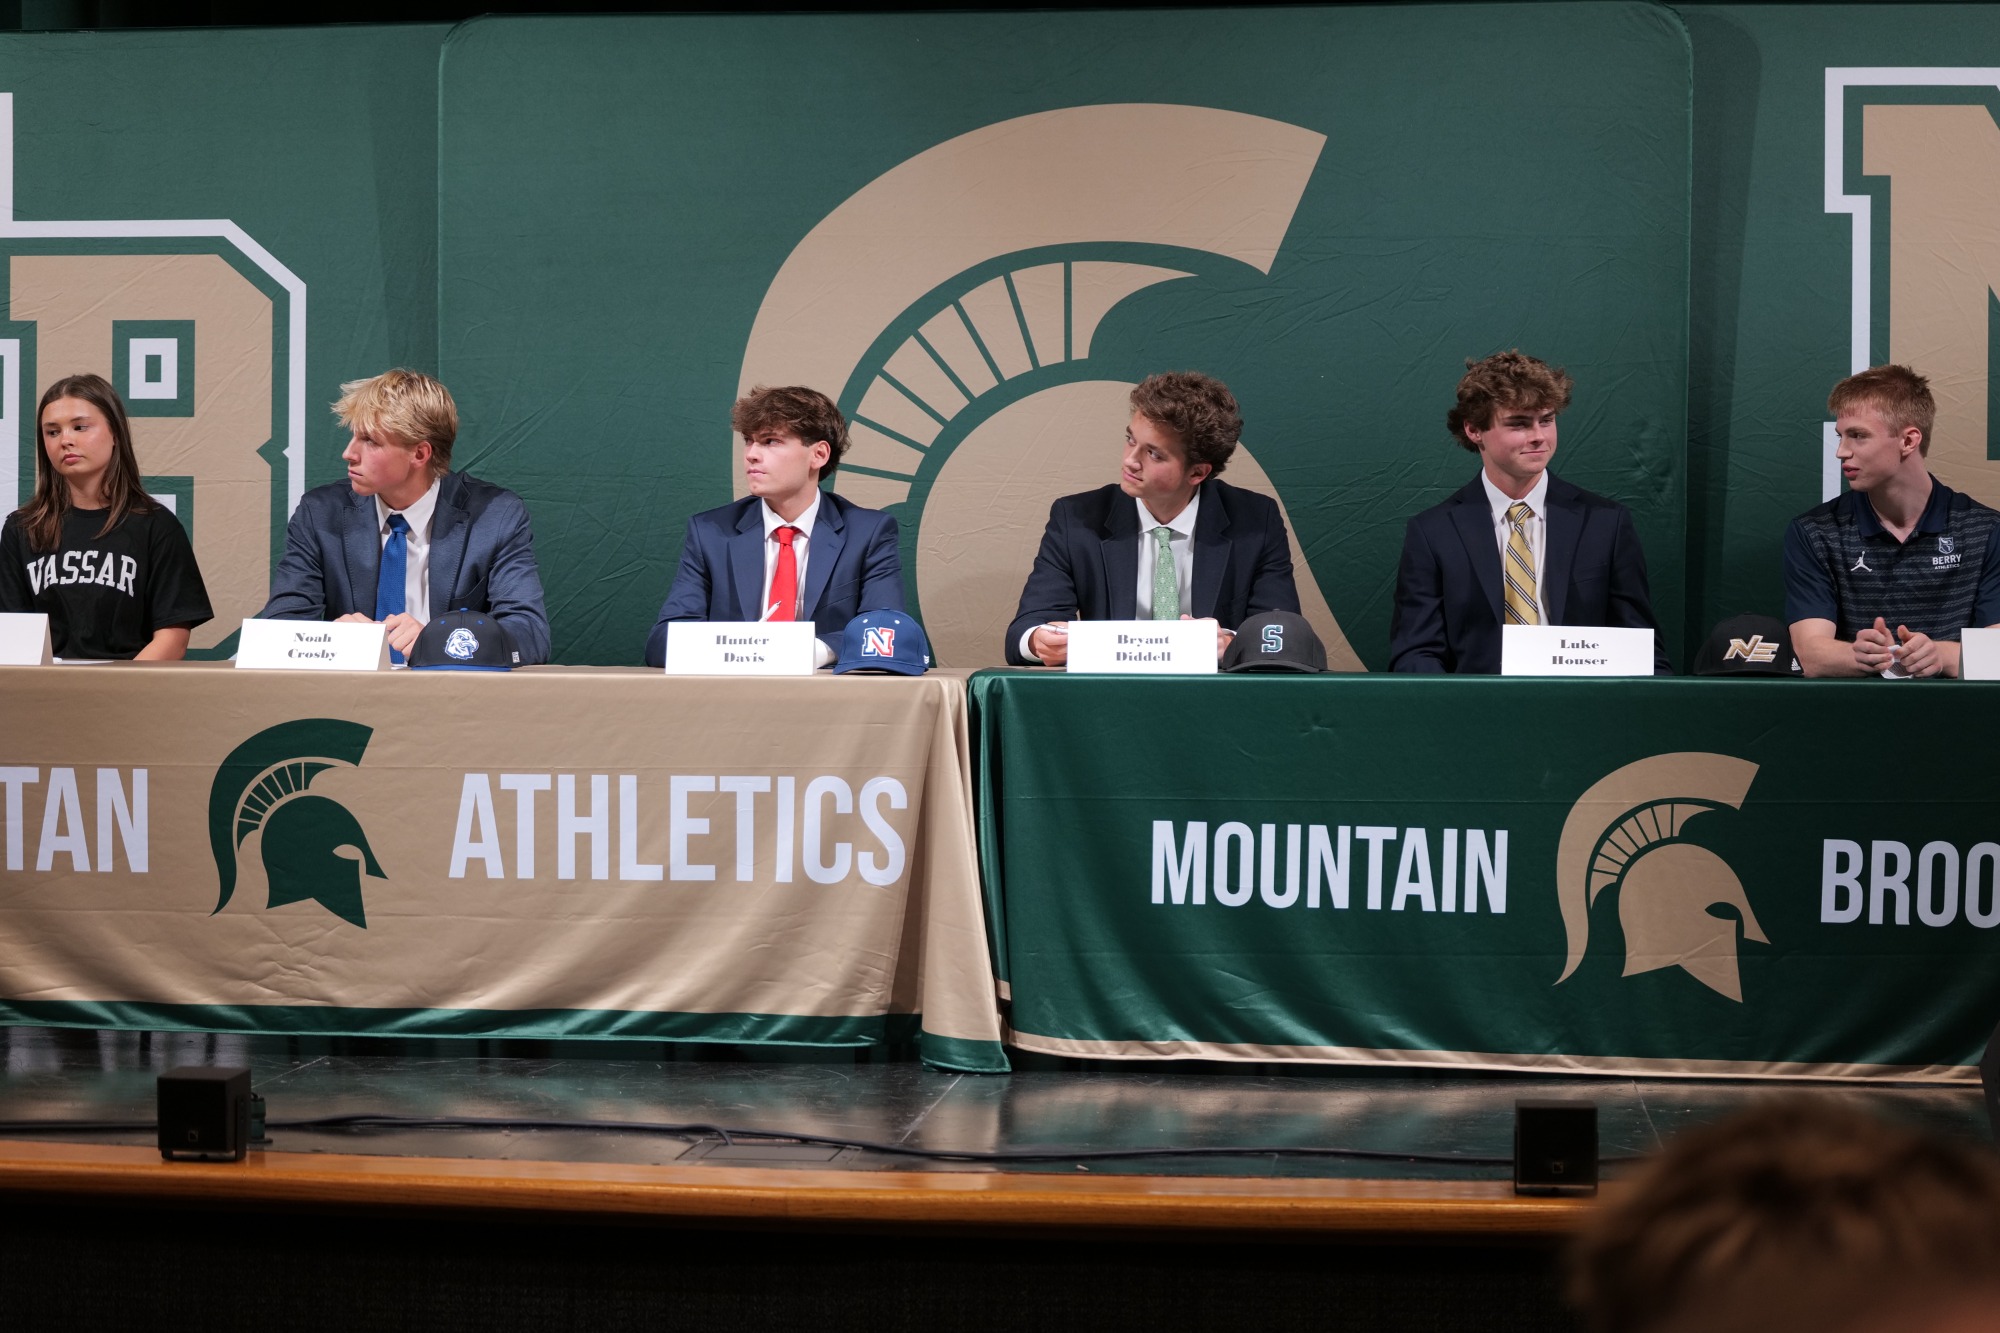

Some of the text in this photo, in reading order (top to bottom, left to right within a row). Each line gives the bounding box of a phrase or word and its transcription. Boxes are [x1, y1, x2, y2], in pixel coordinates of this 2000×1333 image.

[1932, 554, 1961, 565] BERRY
[26, 550, 138, 598] VASSAR
[293, 632, 332, 643] Noah
[715, 635, 769, 645] Hunter
[862, 627, 895, 657] N
[1117, 634, 1169, 646] Bryant
[1261, 624, 1283, 653] S
[1560, 639, 1600, 650] Luke
[287, 648, 337, 661] Crosby
[723, 652, 765, 663] Davis
[1116, 651, 1171, 662] Diddell
[1552, 655, 1608, 666] Houser
[0, 766, 908, 887] TAN ATHLETICS
[1151, 819, 2000, 929] MOUNTAIN BROO
